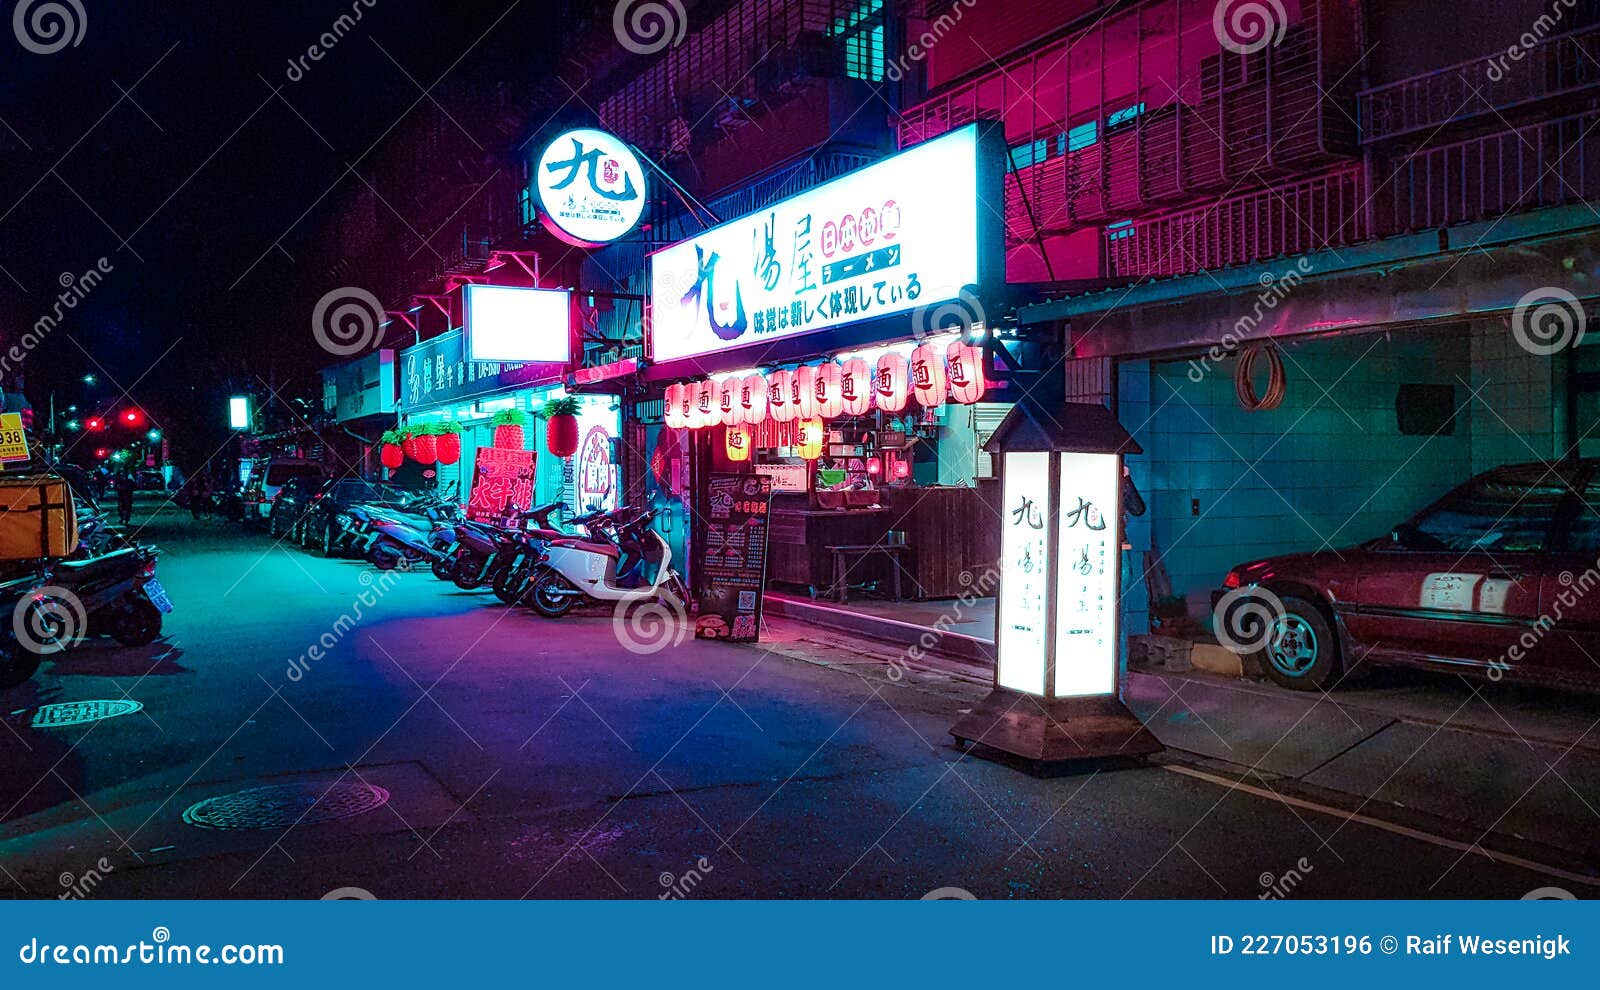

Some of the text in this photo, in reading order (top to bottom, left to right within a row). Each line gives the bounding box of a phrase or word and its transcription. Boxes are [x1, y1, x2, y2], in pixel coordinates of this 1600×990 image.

[546, 137, 638, 201] 九
[823, 246, 900, 285] ラーメン
